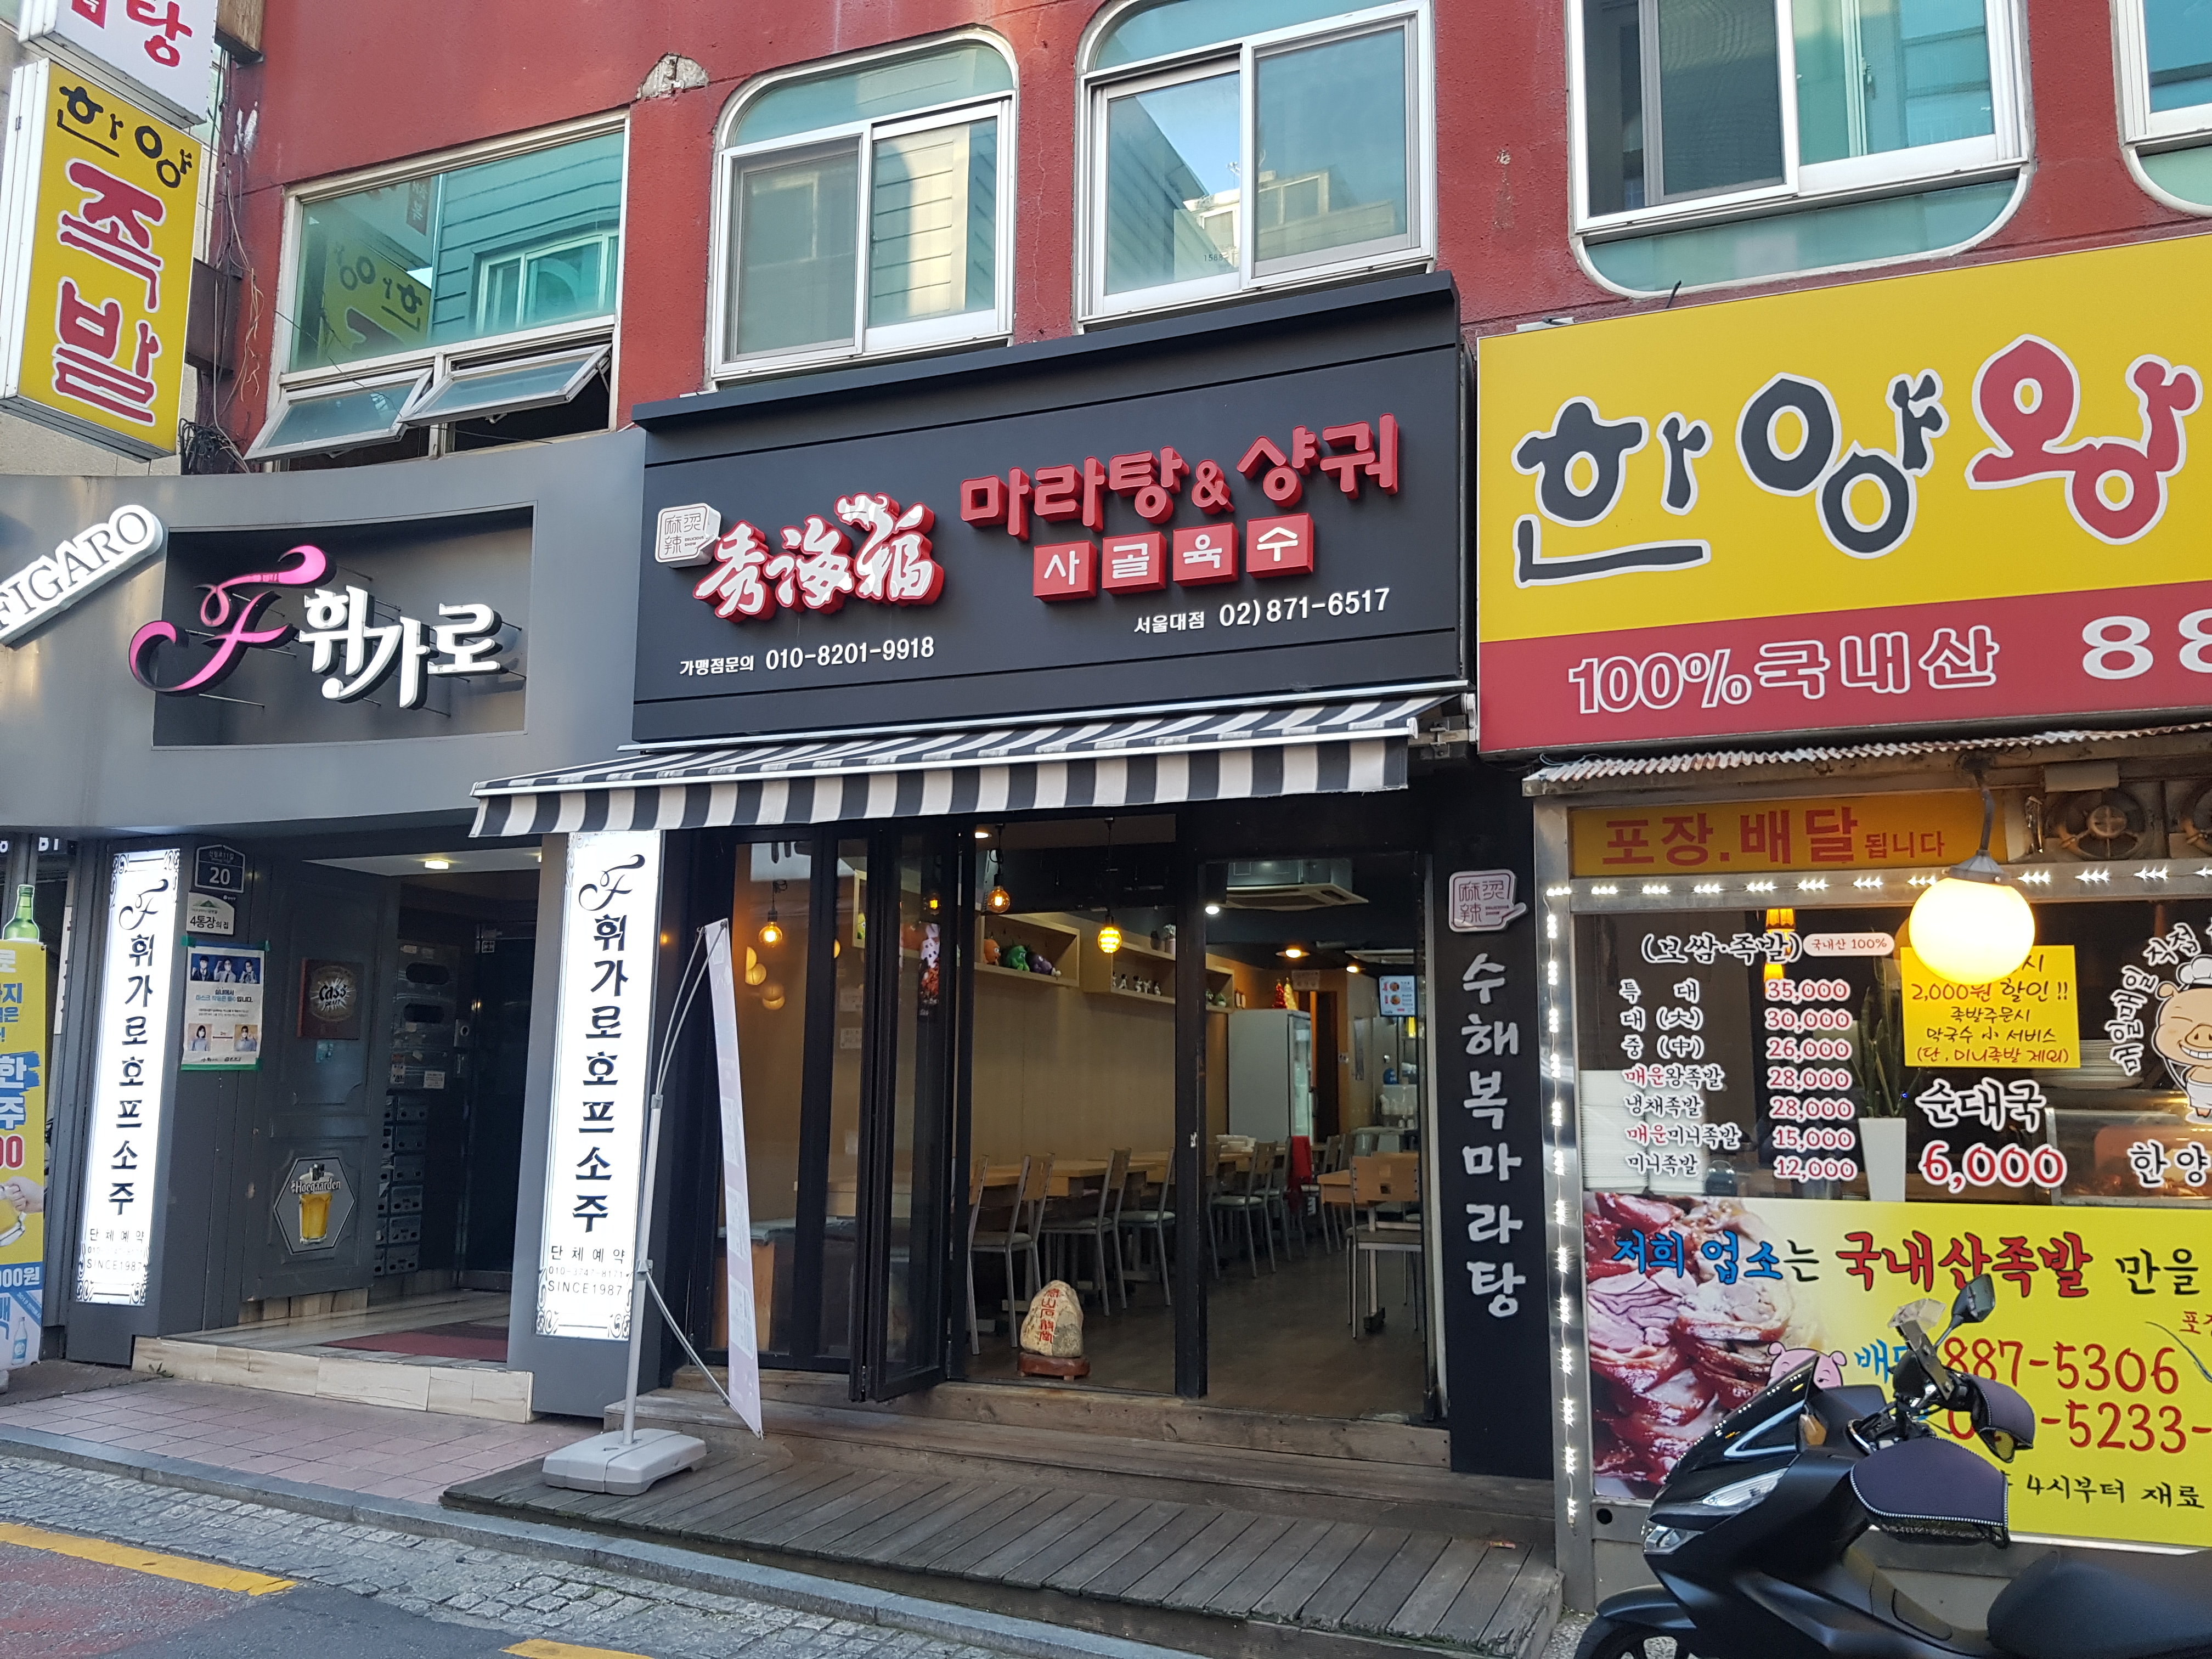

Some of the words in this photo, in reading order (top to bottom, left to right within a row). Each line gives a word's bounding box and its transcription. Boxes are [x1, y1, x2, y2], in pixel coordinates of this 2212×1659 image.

[57, 86, 192, 188] 한양
[57, 158, 166, 426] 족발
[1133, 611, 1205, 634] 서울대점
[1218, 588, 1391, 627] 02)871-6517
[300, 586, 503, 709] 휘가로
[680, 656, 754, 676] 가맹점문의
[765, 636, 935, 670] 010-8201-9918
[1864, 831, 1945, 860] 됩니다
[209, 866, 230, 885] 20
[1811, 939, 1846, 950] 국내산
[1851, 938, 1887, 949] 100%
[1766, 980, 1850, 1004] 35,000
[1766, 1009, 1852, 1032] 30,000
[1950, 1006, 2030, 1024] 족발주문시
[1927, 1026, 1973, 1043] 막국수
[2006, 1028, 2057, 1043] 서비스
[1767, 1039, 1852, 1063] 26,000
[1954, 1046, 2022, 1063] 미니족발
[1768, 1067, 1852, 1092] 28,000
[1624, 1096, 1704, 1118] 냉채족발
[1770, 1097, 1855, 1122] 28,000
[1917, 1079, 2045, 1131] 순대국
[1773, 1126, 1855, 1150] 15,000
[1627, 1154, 1699, 1177] 미니족발
[1774, 1156, 1858, 1181] 12,000
[1921, 1142, 2066, 1192] 6,000
[295, 1177, 341, 1193] Hoegaarden
[1612, 1228, 1684, 1278] 저희
[2115, 1248, 2200, 1295] 만을
[1944, 1336, 2180, 1395] 887-5306
[2027, 1474, 2125, 1504] 4시부터
[2141, 1481, 2205, 1509] 재료
